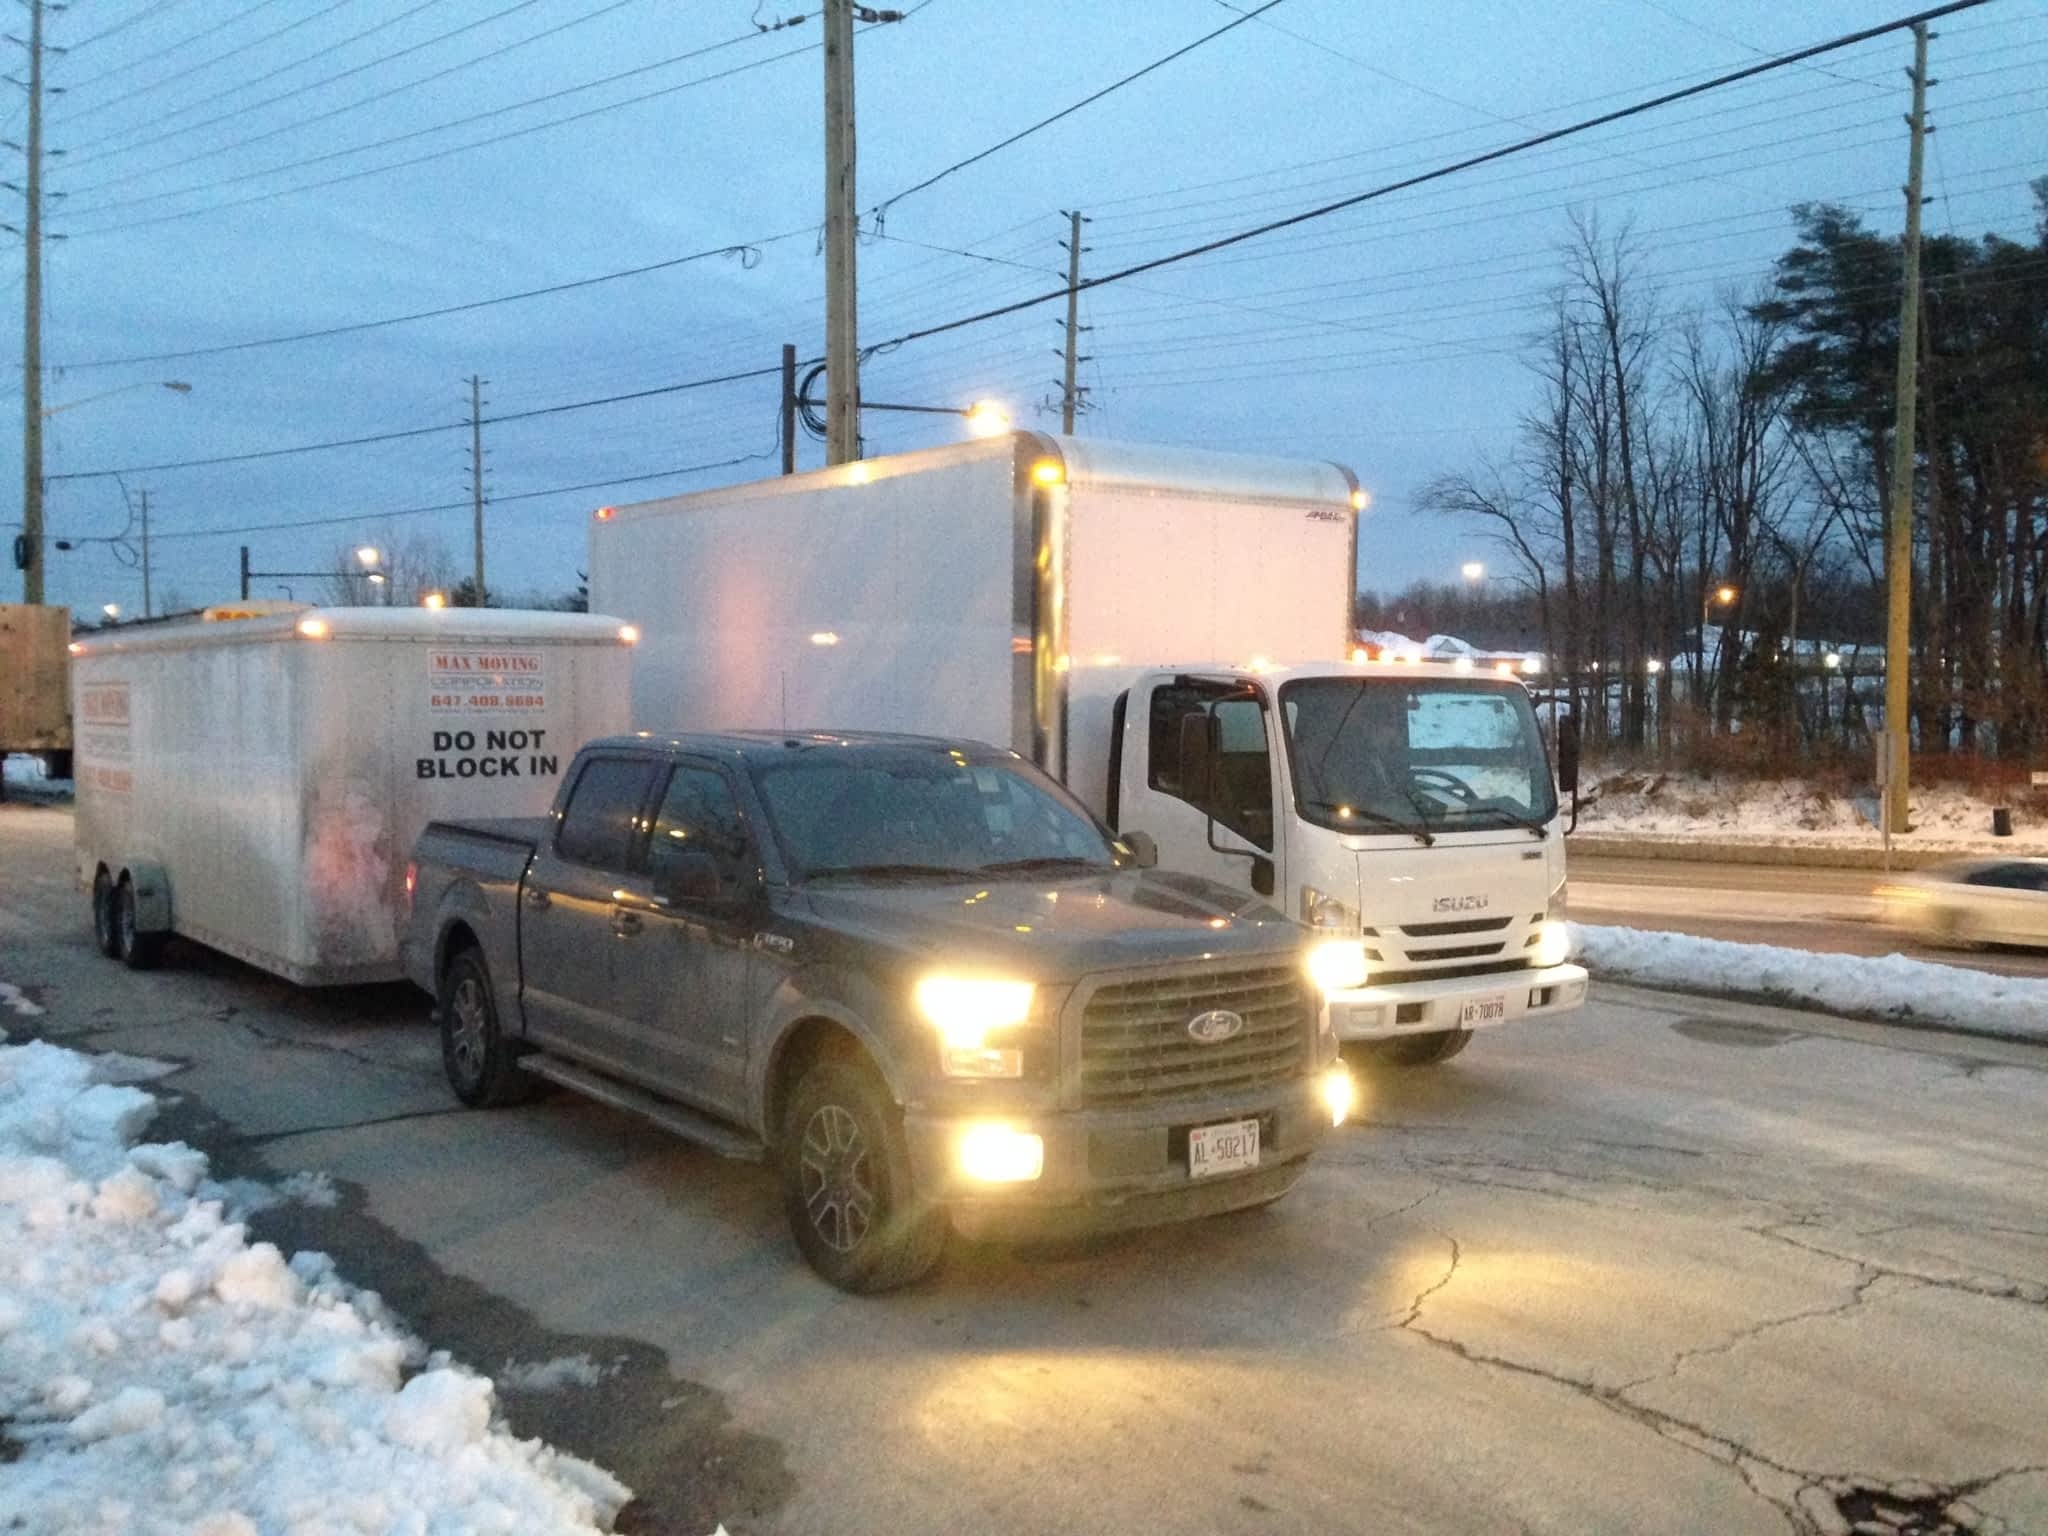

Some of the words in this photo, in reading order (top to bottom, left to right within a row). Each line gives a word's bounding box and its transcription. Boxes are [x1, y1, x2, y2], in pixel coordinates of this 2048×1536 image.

[435, 656, 472, 671] MAX
[478, 656, 538, 672] MOVING
[433, 730, 475, 751] DO
[486, 729, 546, 750] NOT
[416, 756, 520, 779] BLOCK
[530, 755, 558, 775] IN
[1432, 894, 1489, 913] ISUZU
